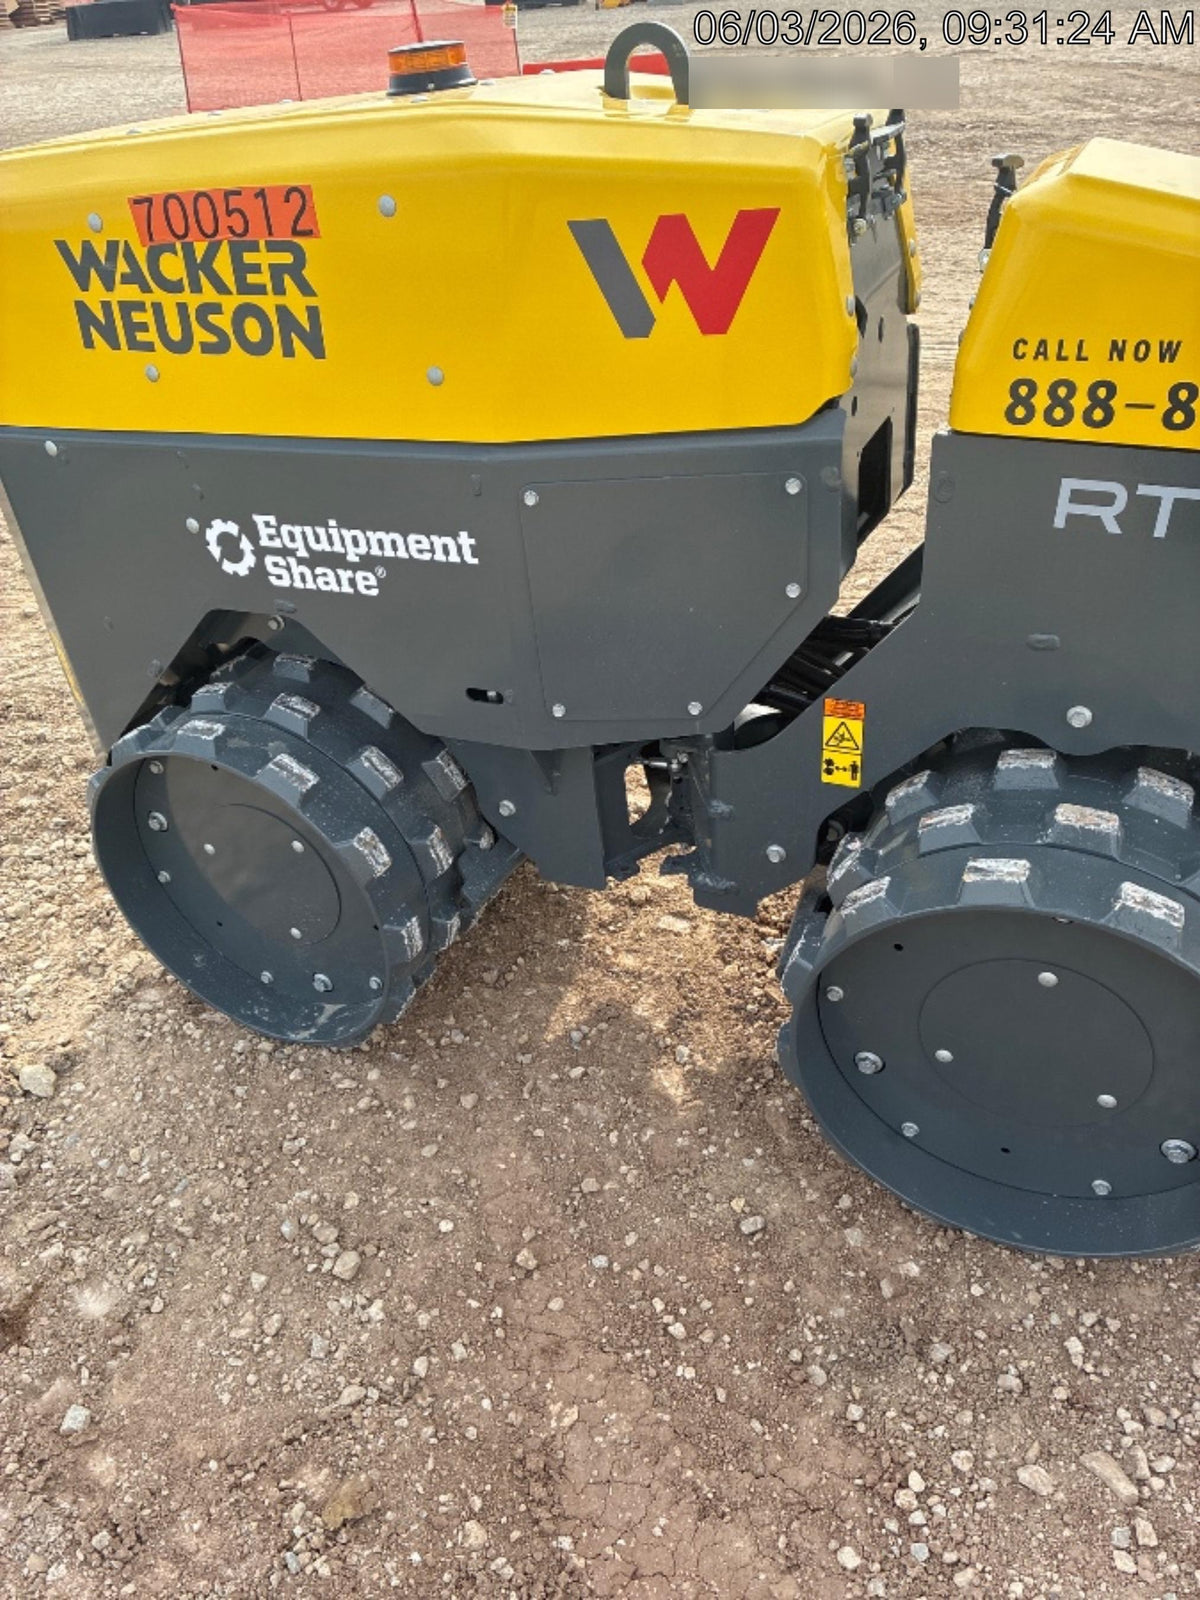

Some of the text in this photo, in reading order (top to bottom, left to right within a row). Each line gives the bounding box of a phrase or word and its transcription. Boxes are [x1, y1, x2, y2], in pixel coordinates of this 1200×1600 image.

[132, 186, 314, 242] 700512
[53, 239, 318, 297] WACKER
[74, 300, 327, 360] NEUSON
[1012, 338, 1183, 364] CALL NOW
[1004, 378, 1199, 431] 888-8
[1053, 477, 1200, 538] RT
[252, 514, 479, 565] Equipment
